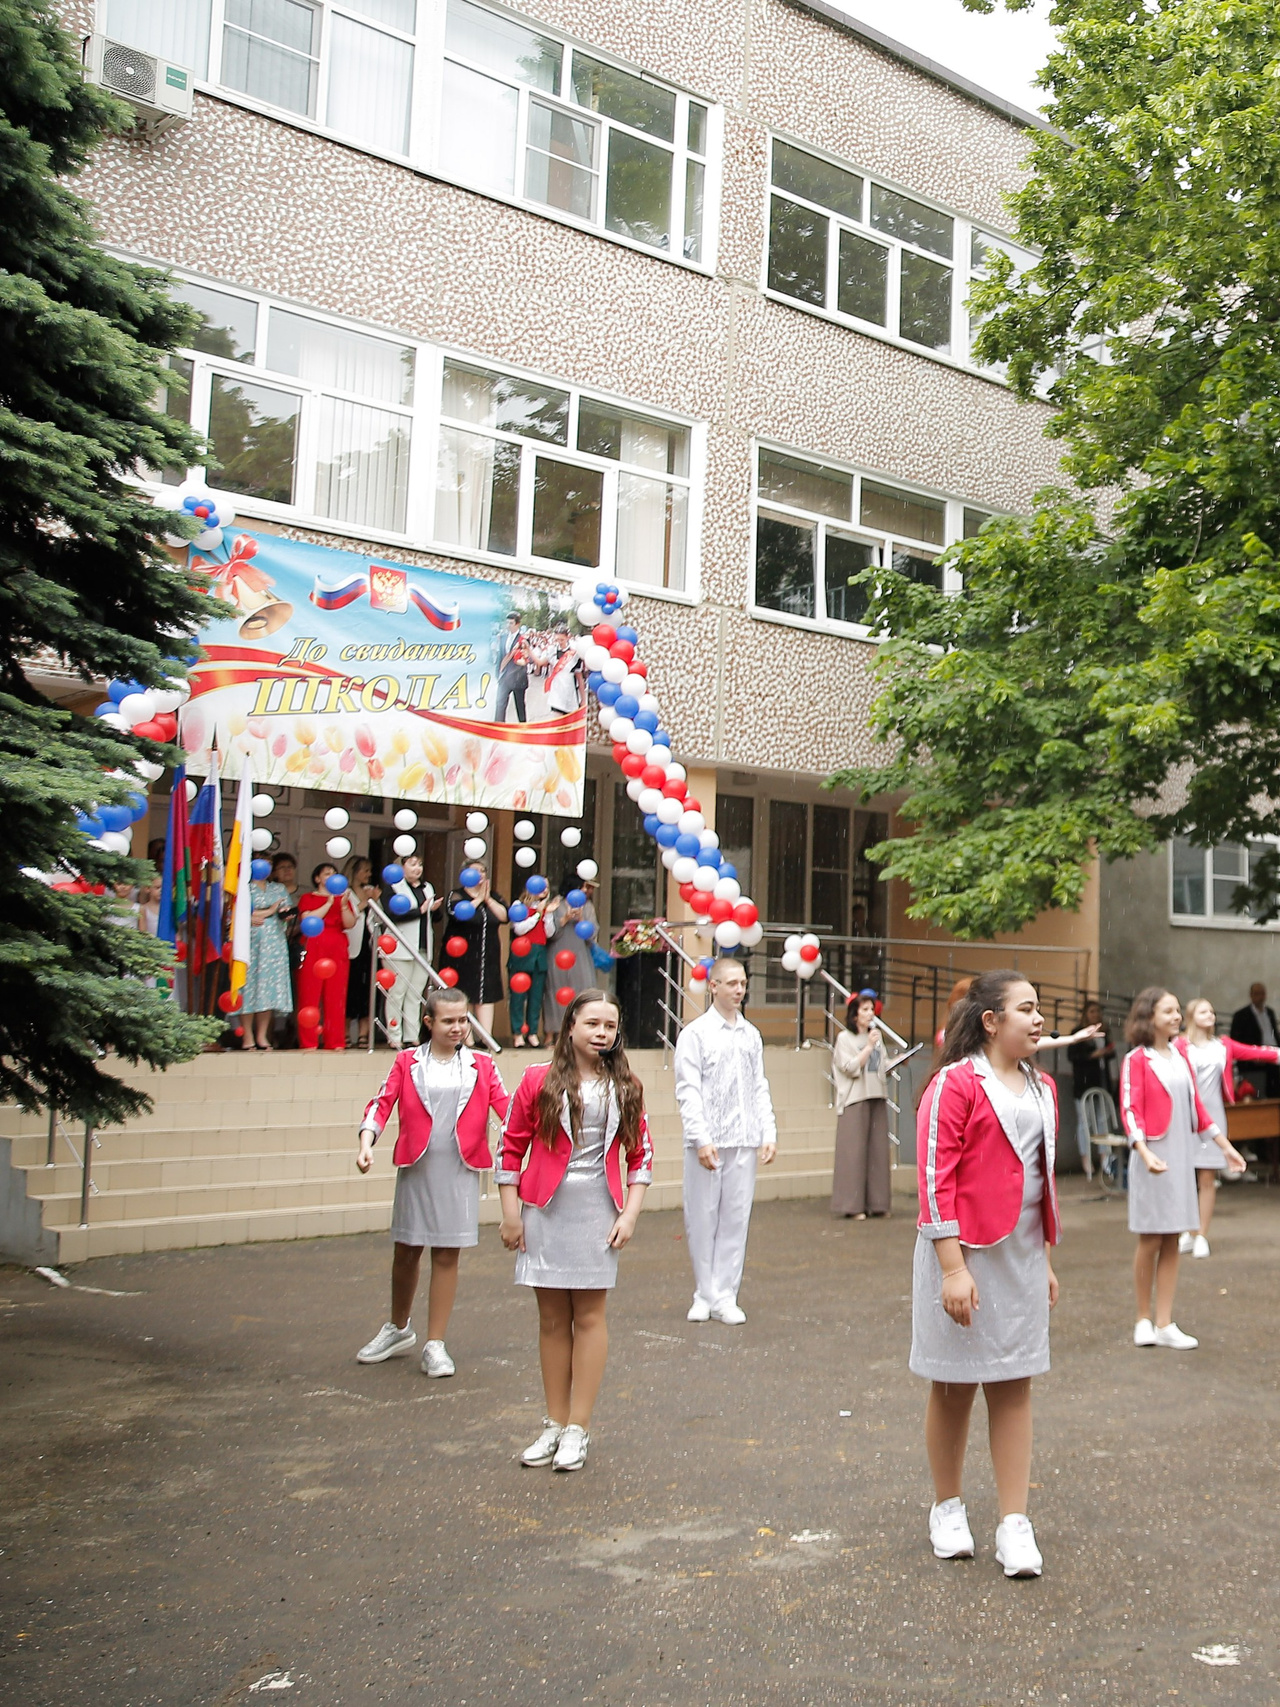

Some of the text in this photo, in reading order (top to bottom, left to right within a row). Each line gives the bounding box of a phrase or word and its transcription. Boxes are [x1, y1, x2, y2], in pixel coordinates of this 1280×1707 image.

[278, 637, 477, 667] До свидания,
[248, 673, 491, 716] ШКОЛА!
